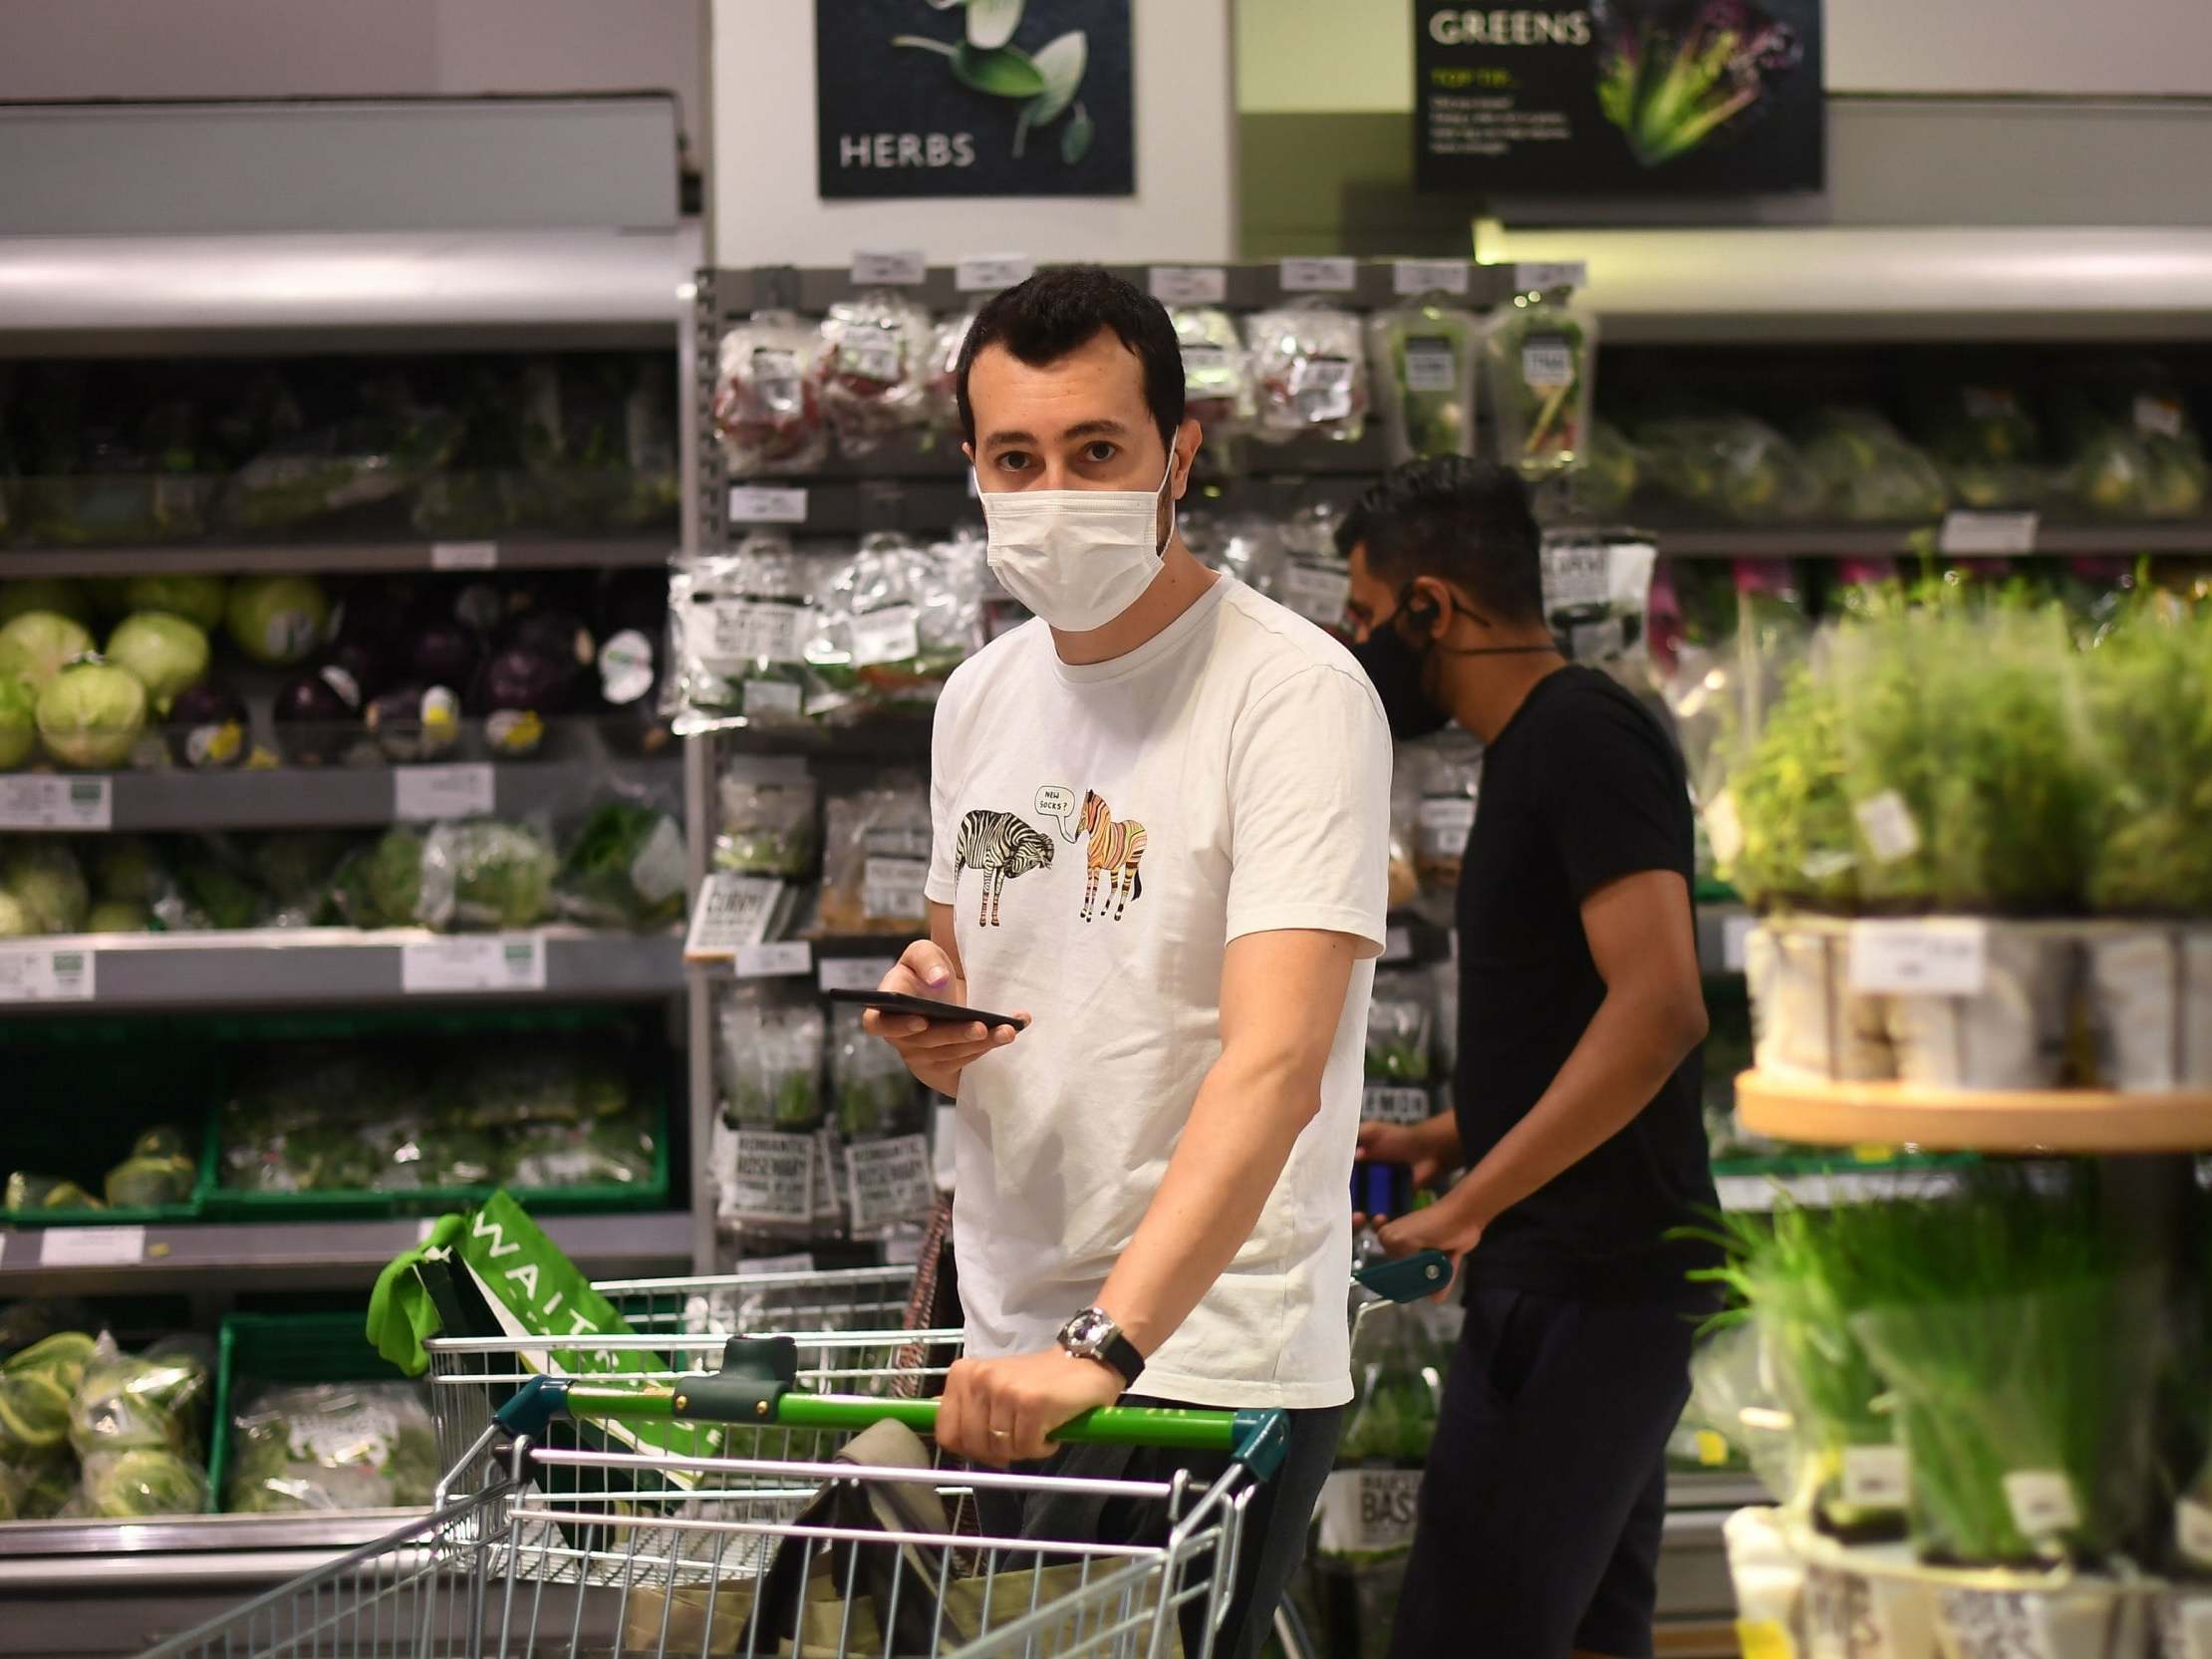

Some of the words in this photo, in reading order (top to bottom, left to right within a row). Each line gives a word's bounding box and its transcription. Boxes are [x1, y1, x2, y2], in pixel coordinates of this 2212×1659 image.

[1429, 9, 1591, 46] GREENS
[839, 133, 975, 167] HERBS
[1360, 1493, 1411, 1523] BAS
